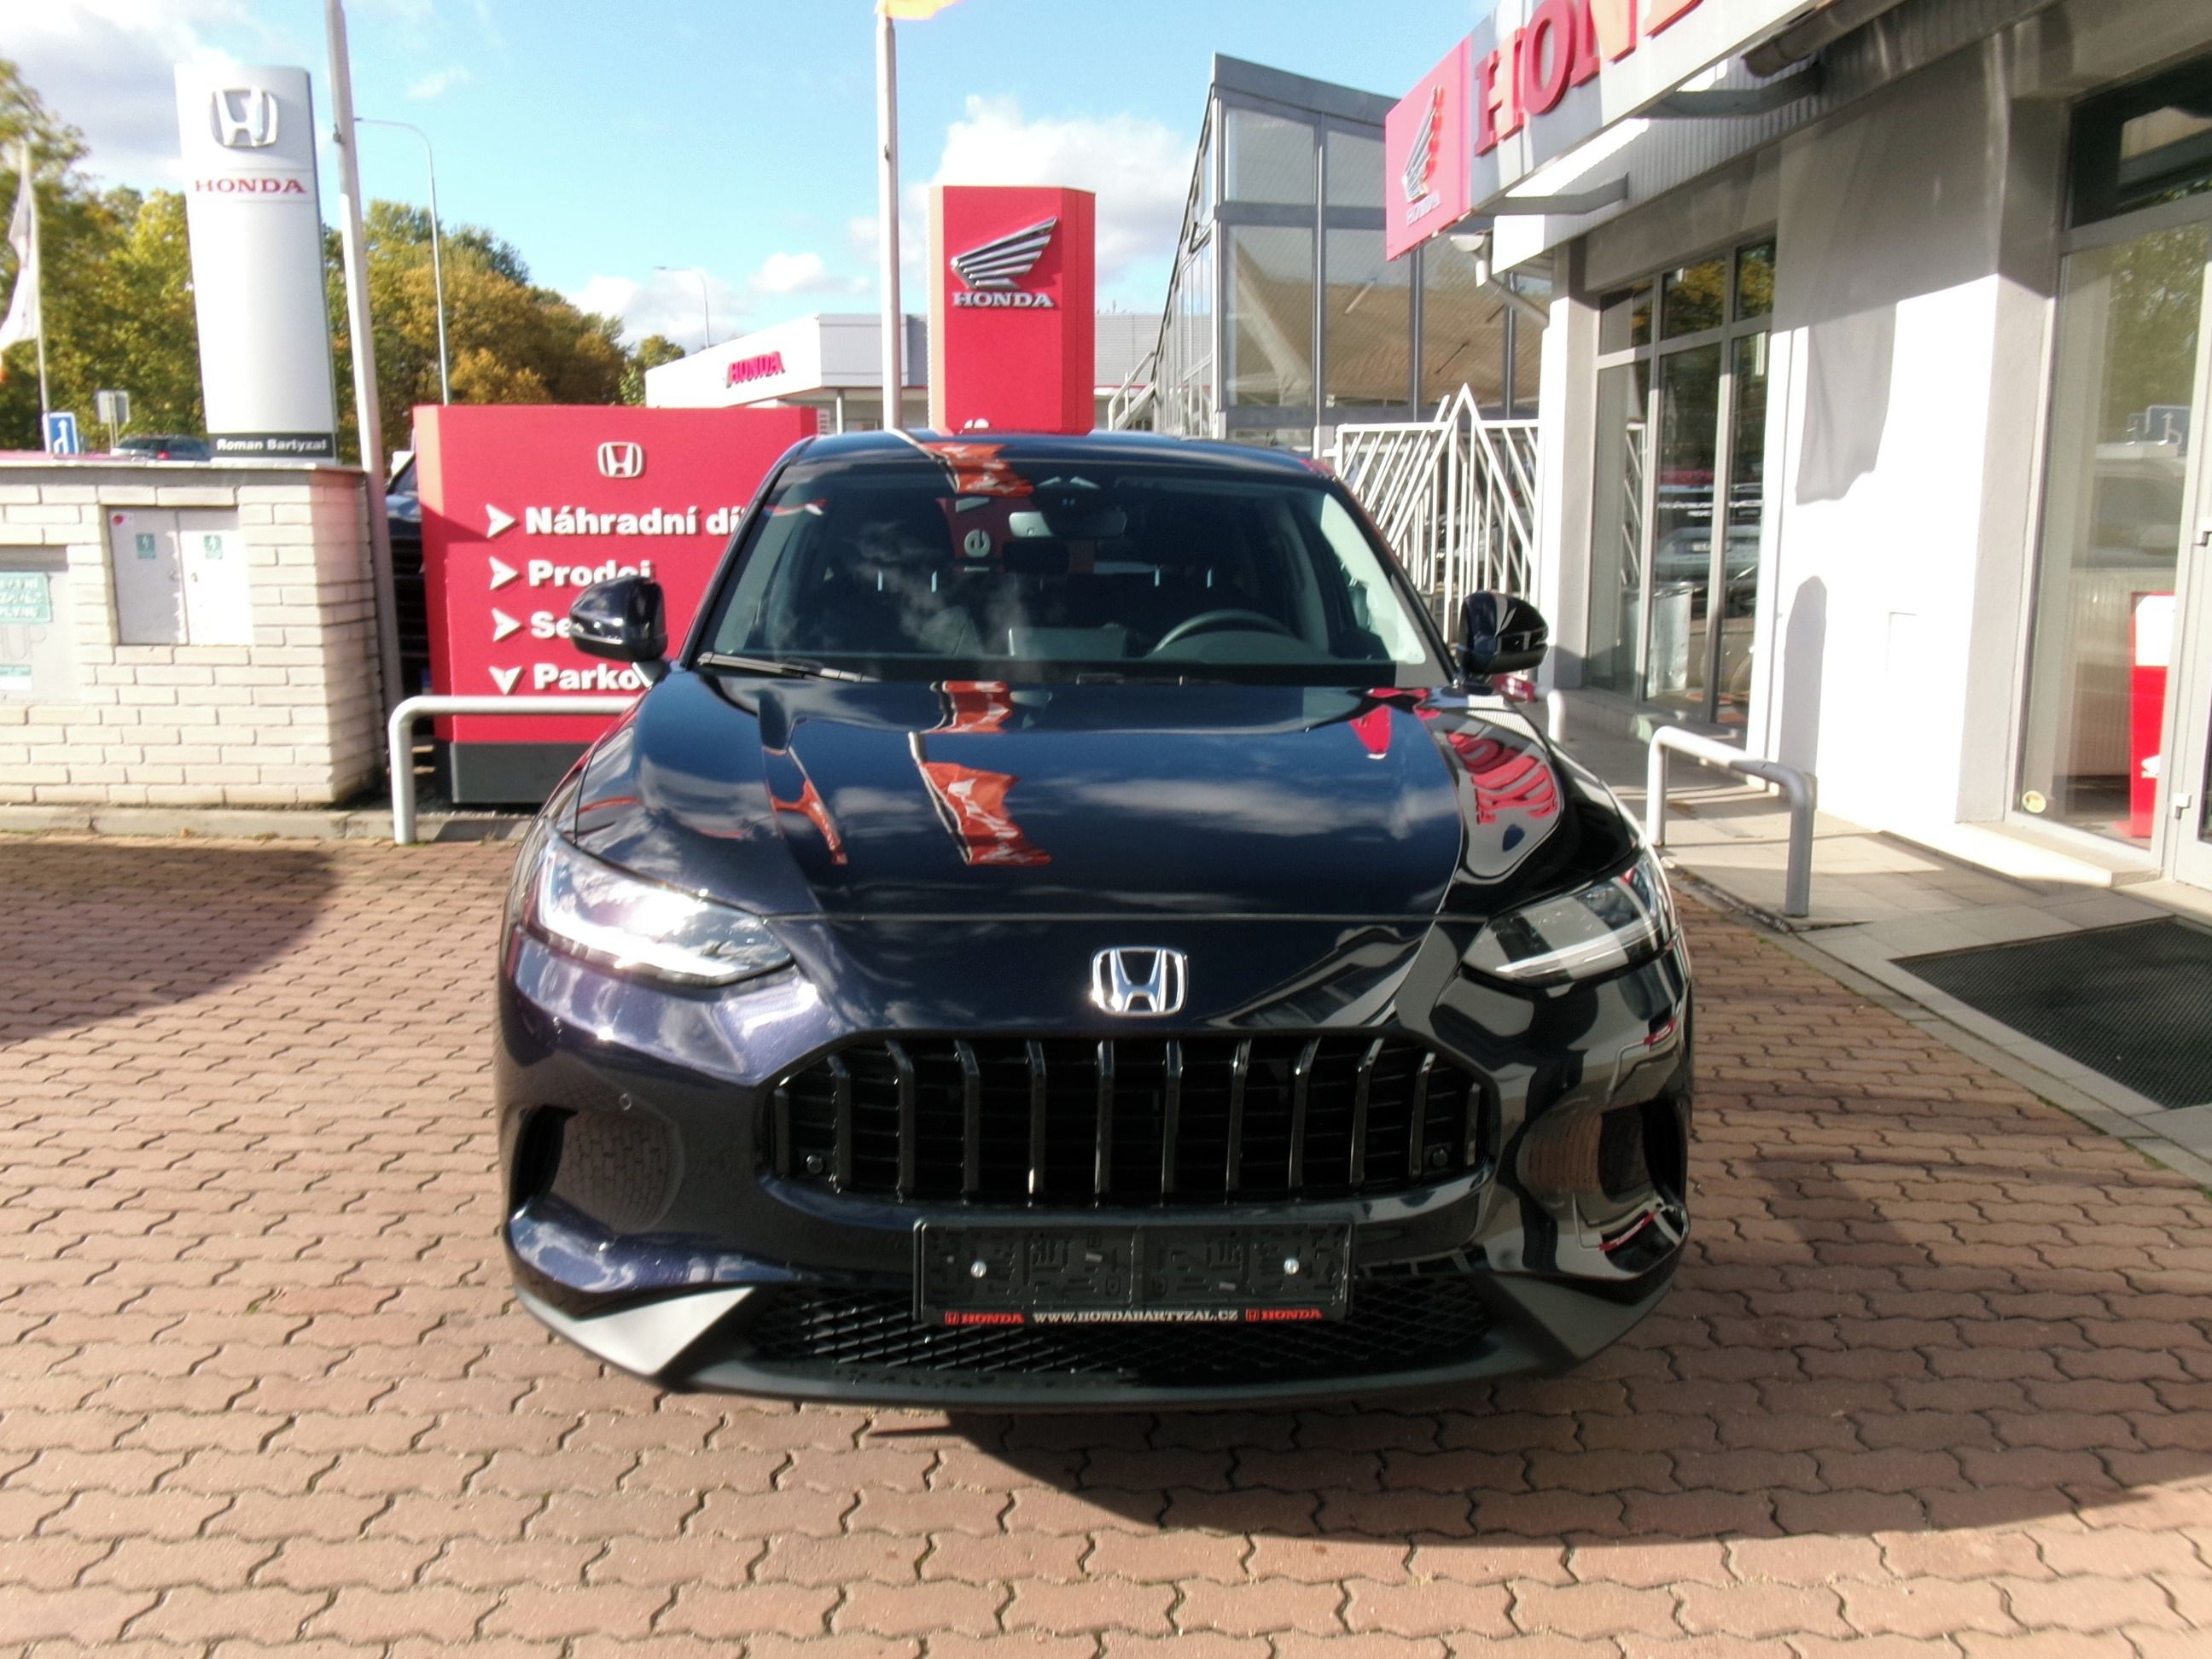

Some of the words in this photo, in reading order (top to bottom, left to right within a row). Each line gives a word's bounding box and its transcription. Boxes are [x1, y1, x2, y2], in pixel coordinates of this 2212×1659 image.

[1474, 0, 1707, 157] HON
[195, 178, 307, 194] HONDA
[953, 291, 1055, 308] HONDA
[727, 351, 784, 387] HONDA
[216, 438, 264, 451] Roman
[265, 438, 327, 452] Bartyzal
[525, 506, 698, 535] Náhradní
[705, 505, 745, 535] dí
[530, 610, 571, 639] Se
[533, 662, 642, 690] Parko
[961, 1312, 1026, 1324] HONDA
[1261, 1308, 1322, 1321] HONDA
